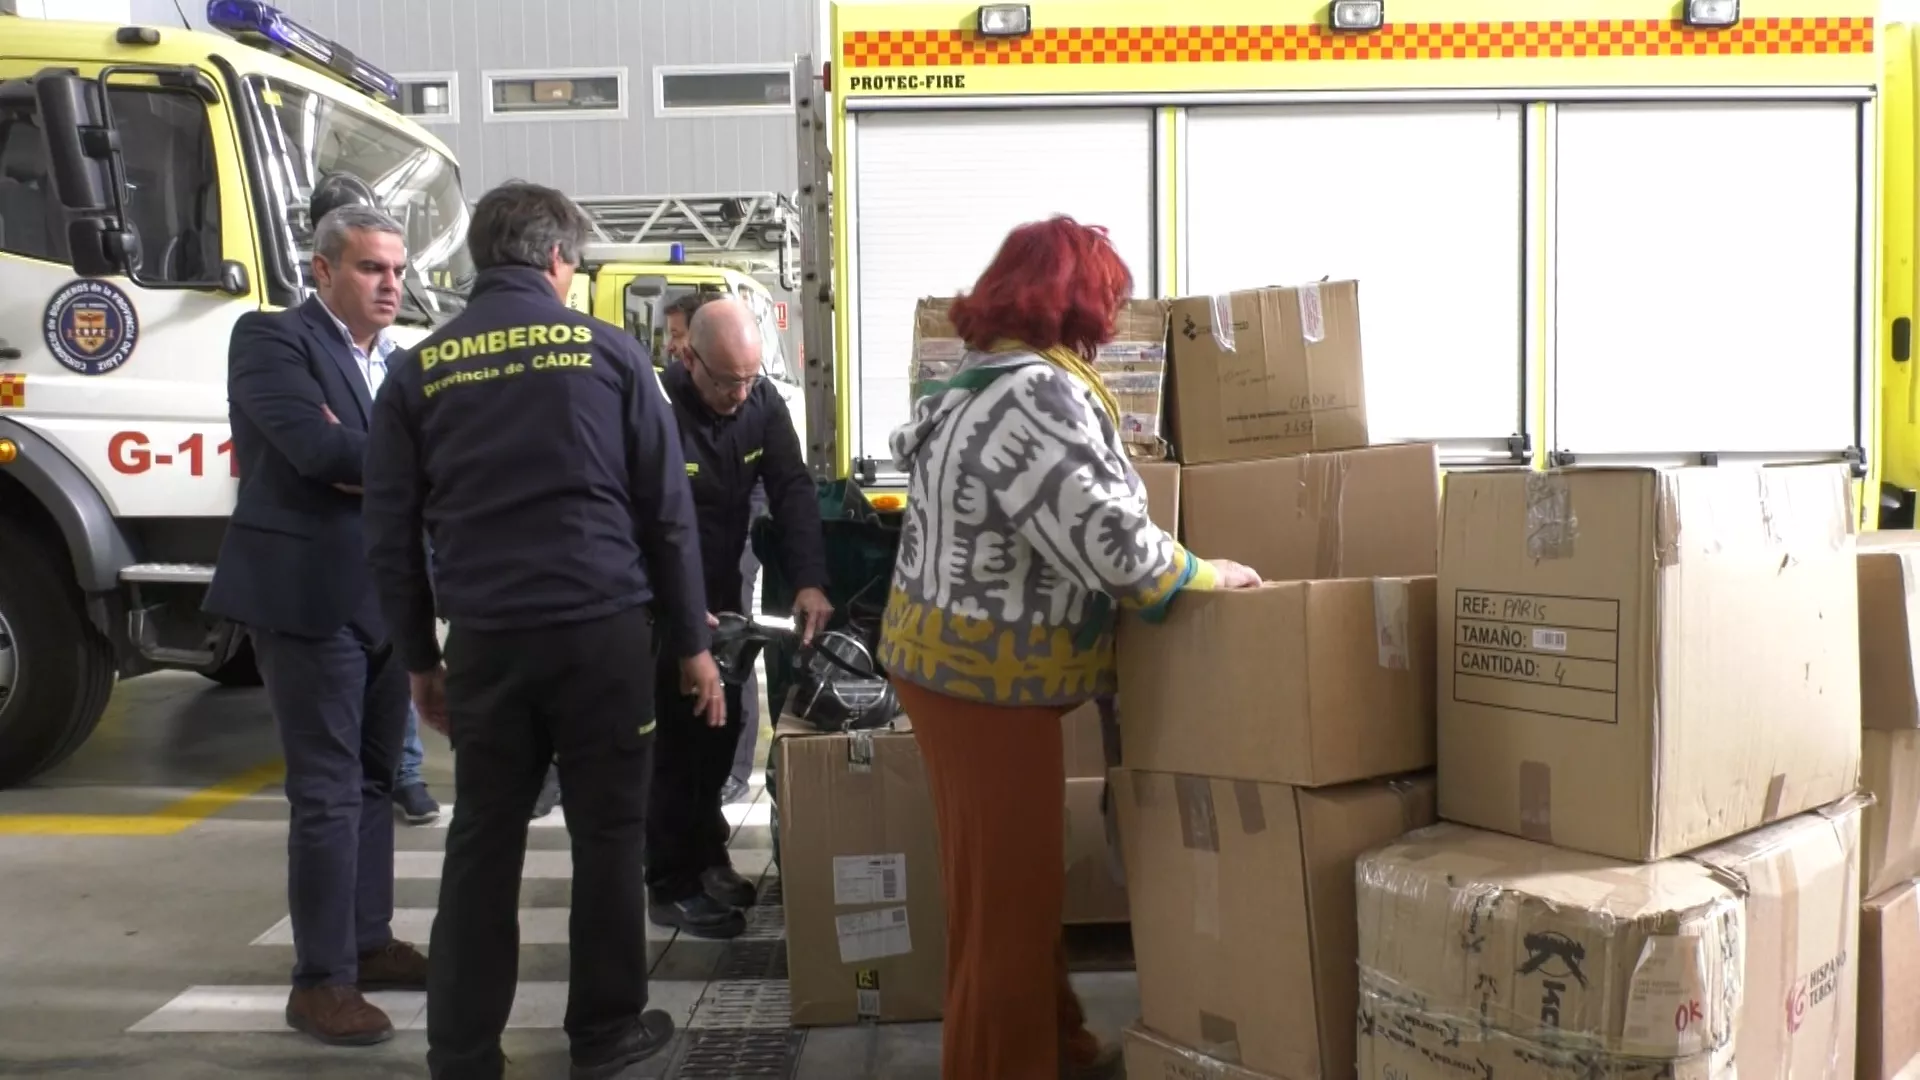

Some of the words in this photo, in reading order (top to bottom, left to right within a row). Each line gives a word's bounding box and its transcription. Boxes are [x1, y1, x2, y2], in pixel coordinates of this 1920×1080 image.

[850, 74, 966, 90] PROTEC-FIRE
[420, 323, 592, 371] BOMBEROS
[423, 366, 500, 398] provincia
[504, 362, 525, 375] de
[532, 352, 592, 369] CÁDIZ
[1462, 596, 1496, 616] REF.:
[1502, 598, 1548, 621] PARIS
[1461, 625, 1527, 648] TAMAÑO:
[1461, 652, 1540, 678] CANTIDAD:
[1554, 660, 1566, 686] 4
[1810, 949, 1847, 989] HISPANO
[1675, 999, 1704, 1032] OK
